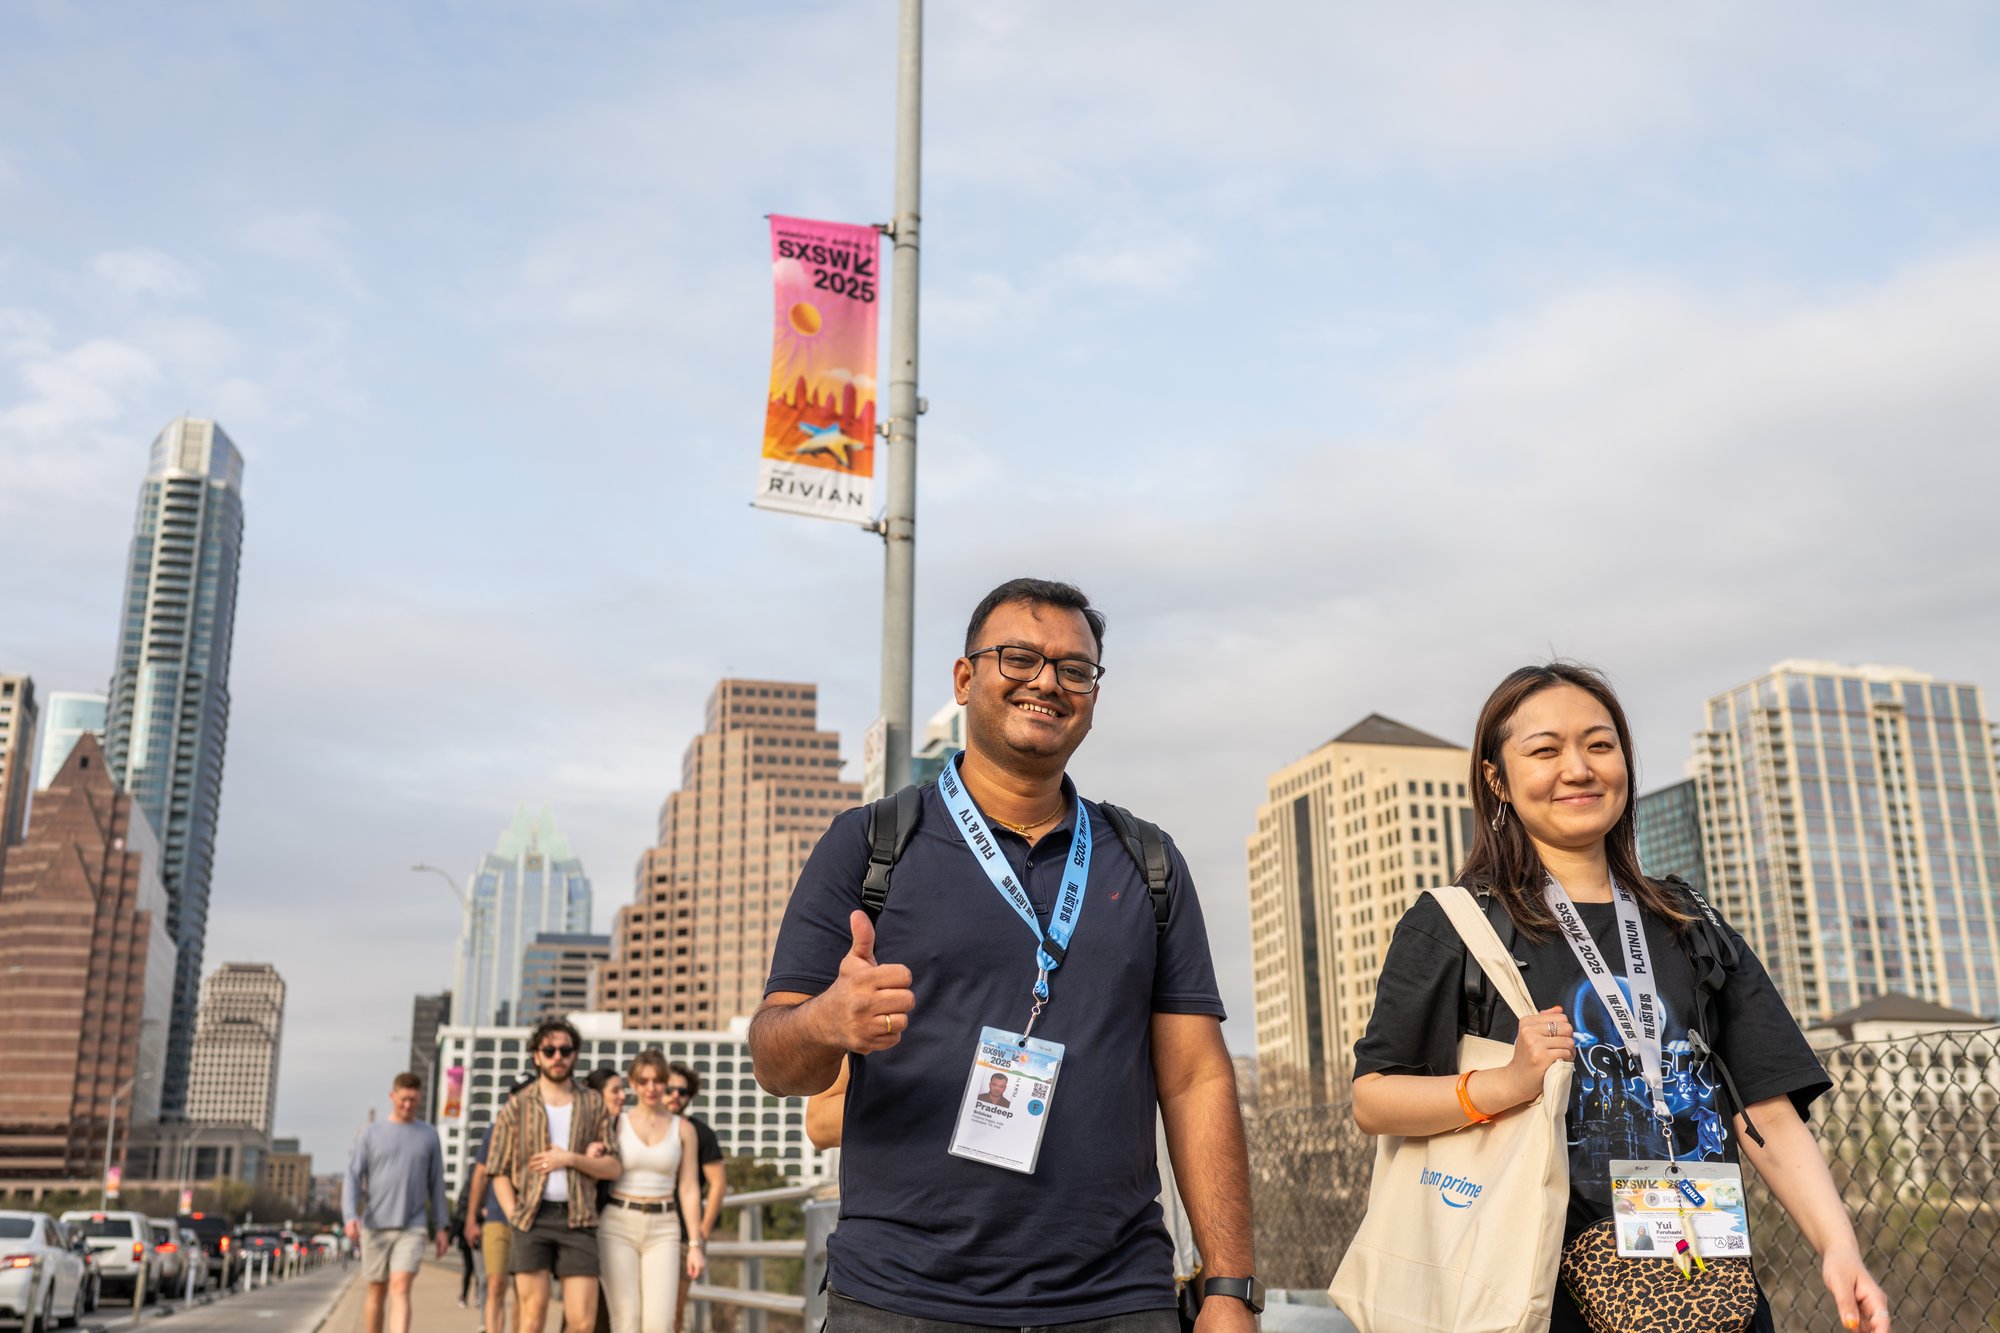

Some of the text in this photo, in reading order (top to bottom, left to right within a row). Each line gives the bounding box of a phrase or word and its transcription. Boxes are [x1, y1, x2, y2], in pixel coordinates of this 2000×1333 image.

[779, 240, 849, 270] SXSW
[814, 269, 875, 303] 2025
[769, 478, 862, 506] RIVIAN
[959, 808, 996, 860] FILM & TV
[1073, 839, 1087, 868] 2025
[1002, 876, 1012, 889] US
[1008, 884, 1018, 896] OF
[1067, 881, 1078, 894] THE
[1014, 892, 1028, 910] LAST
[1064, 890, 1076, 908] LAST
[1025, 906, 1034, 920] THE
[1062, 905, 1072, 916] OF
[1689, 890, 1720, 926] MILLET
[1060, 912, 1071, 924] US
[1555, 902, 1604, 975] SXSW 2025
[1624, 920, 1646, 974] PLATINUM
[1606, 994, 1621, 1005] THE
[1612, 1006, 1628, 1022] LAST
[1639, 993, 1656, 1040] THE LAST OF US
[1620, 1022, 1632, 1030] OF
[1624, 1030, 1638, 1040] US
[982, 1046, 1006, 1058] SXSW
[990, 1056, 1011, 1068] 2025
[975, 1101, 1014, 1119] Pradeep
[1429, 1171, 1442, 1186] on
[1439, 1176, 1482, 1198] prime
[1614, 1180, 1646, 1190] SXSW
[1656, 1221, 1672, 1230] Yui
